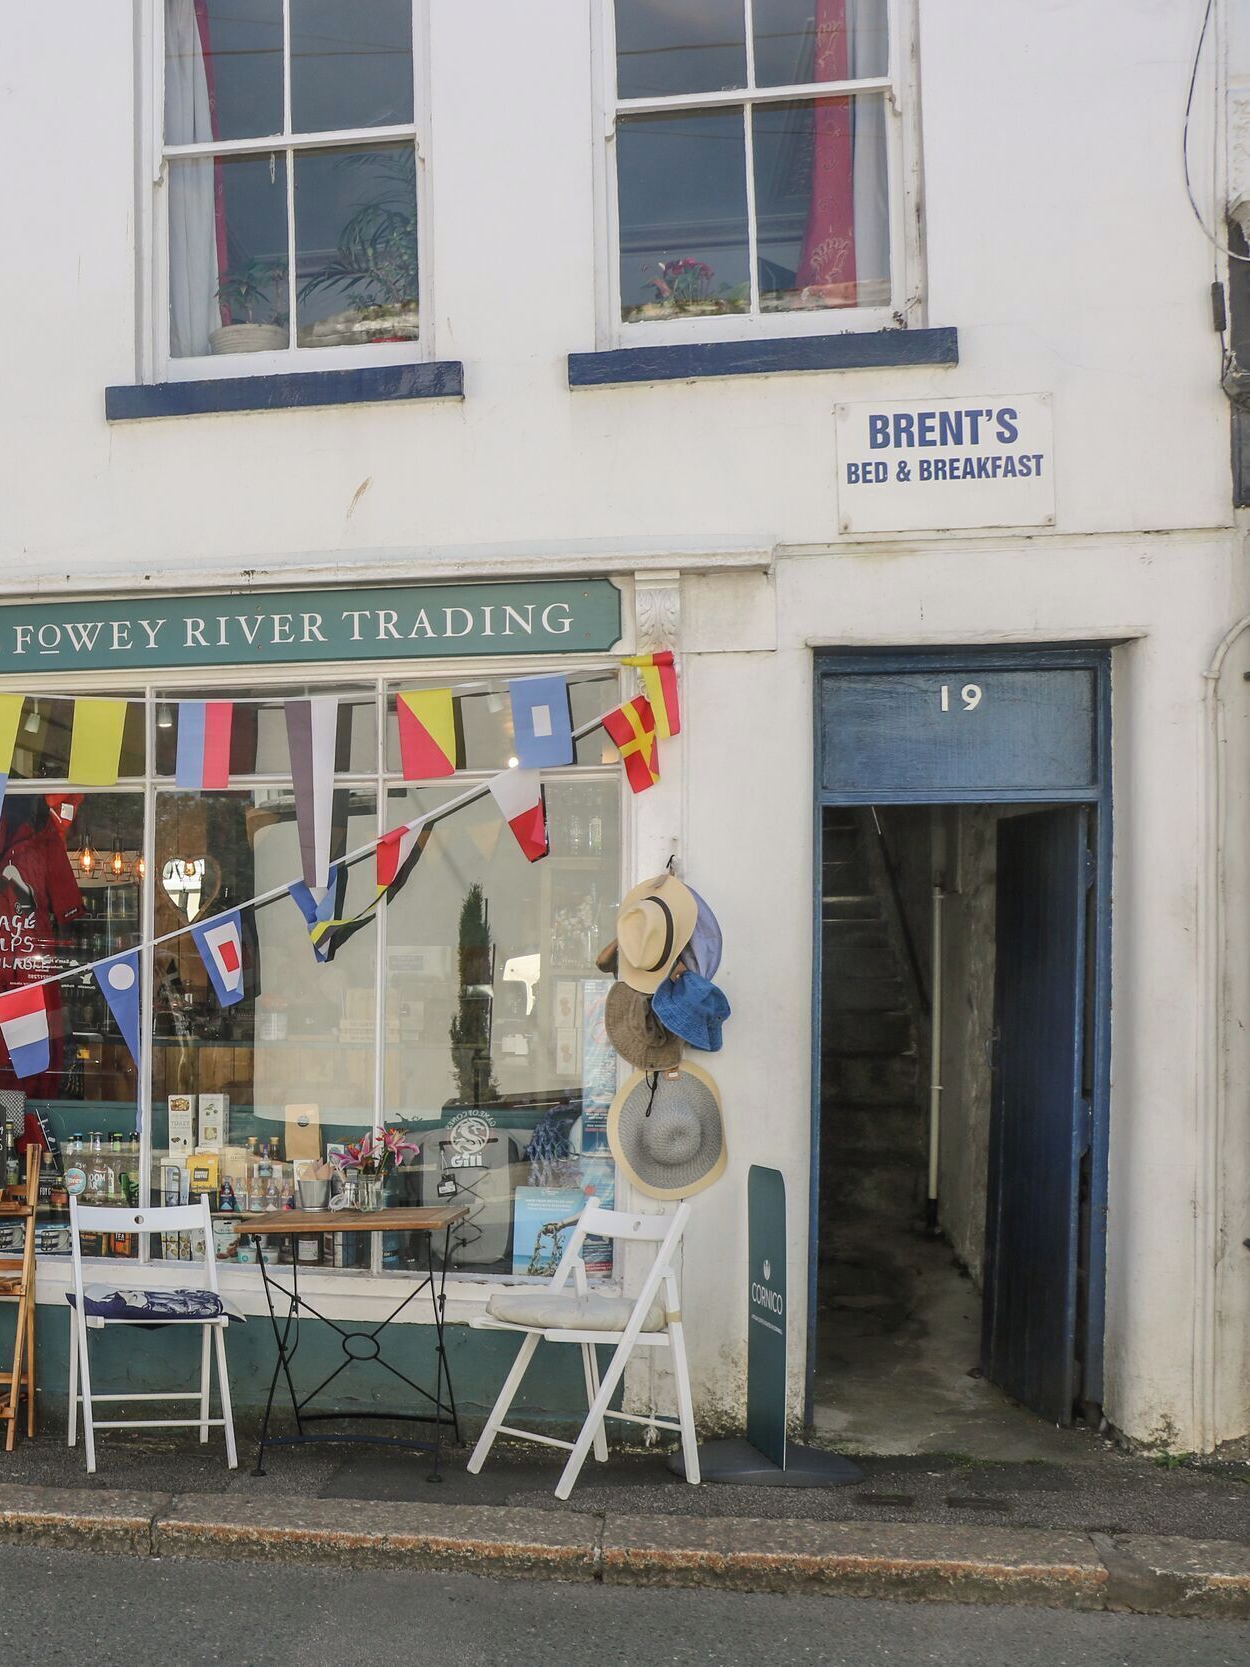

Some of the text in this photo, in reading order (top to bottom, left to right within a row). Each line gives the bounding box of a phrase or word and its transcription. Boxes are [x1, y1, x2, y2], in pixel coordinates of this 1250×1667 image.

[868, 407, 1019, 450] BRENT'S
[847, 454, 1044, 484] BED & BREAKFAST
[12, 602, 575, 655] FOWEY RIVER TRADING
[941, 683, 982, 711] 19
[450, 1151, 483, 1168] Gill
[751, 1282, 784, 1315] CORNICO
